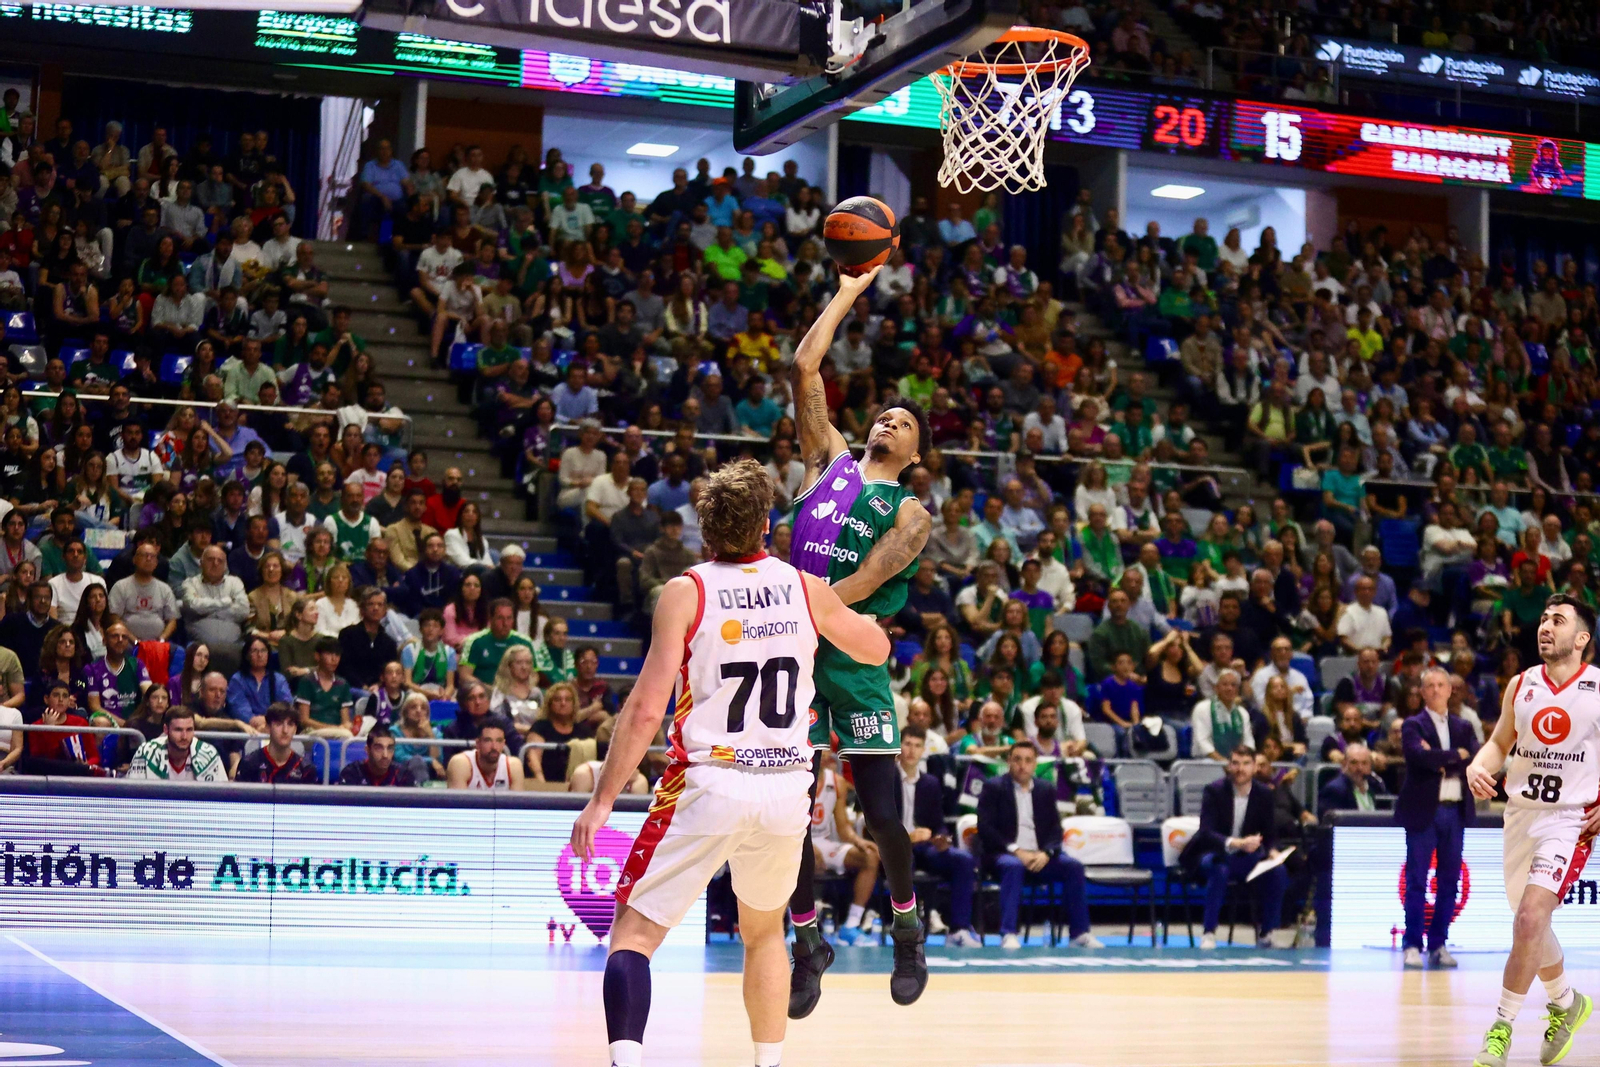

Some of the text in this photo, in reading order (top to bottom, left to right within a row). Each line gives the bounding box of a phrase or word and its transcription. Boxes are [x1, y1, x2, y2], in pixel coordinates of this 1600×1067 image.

[1343, 43, 1405, 63] Fundación
[1444, 57, 1505, 76] Fundación
[1543, 69, 1600, 87] Fundación
[1153, 105, 1206, 146] 20
[1261, 110, 1302, 161] 15
[717, 584, 792, 610] DELANY
[720, 656, 800, 733] 70
[735, 746, 799, 759] GOBIERNO
[1516, 746, 1585, 763] Casademont
[0, 842, 471, 896] isión de Andalucía.
[567, 856, 622, 895] 10
[547, 916, 575, 941] tv
